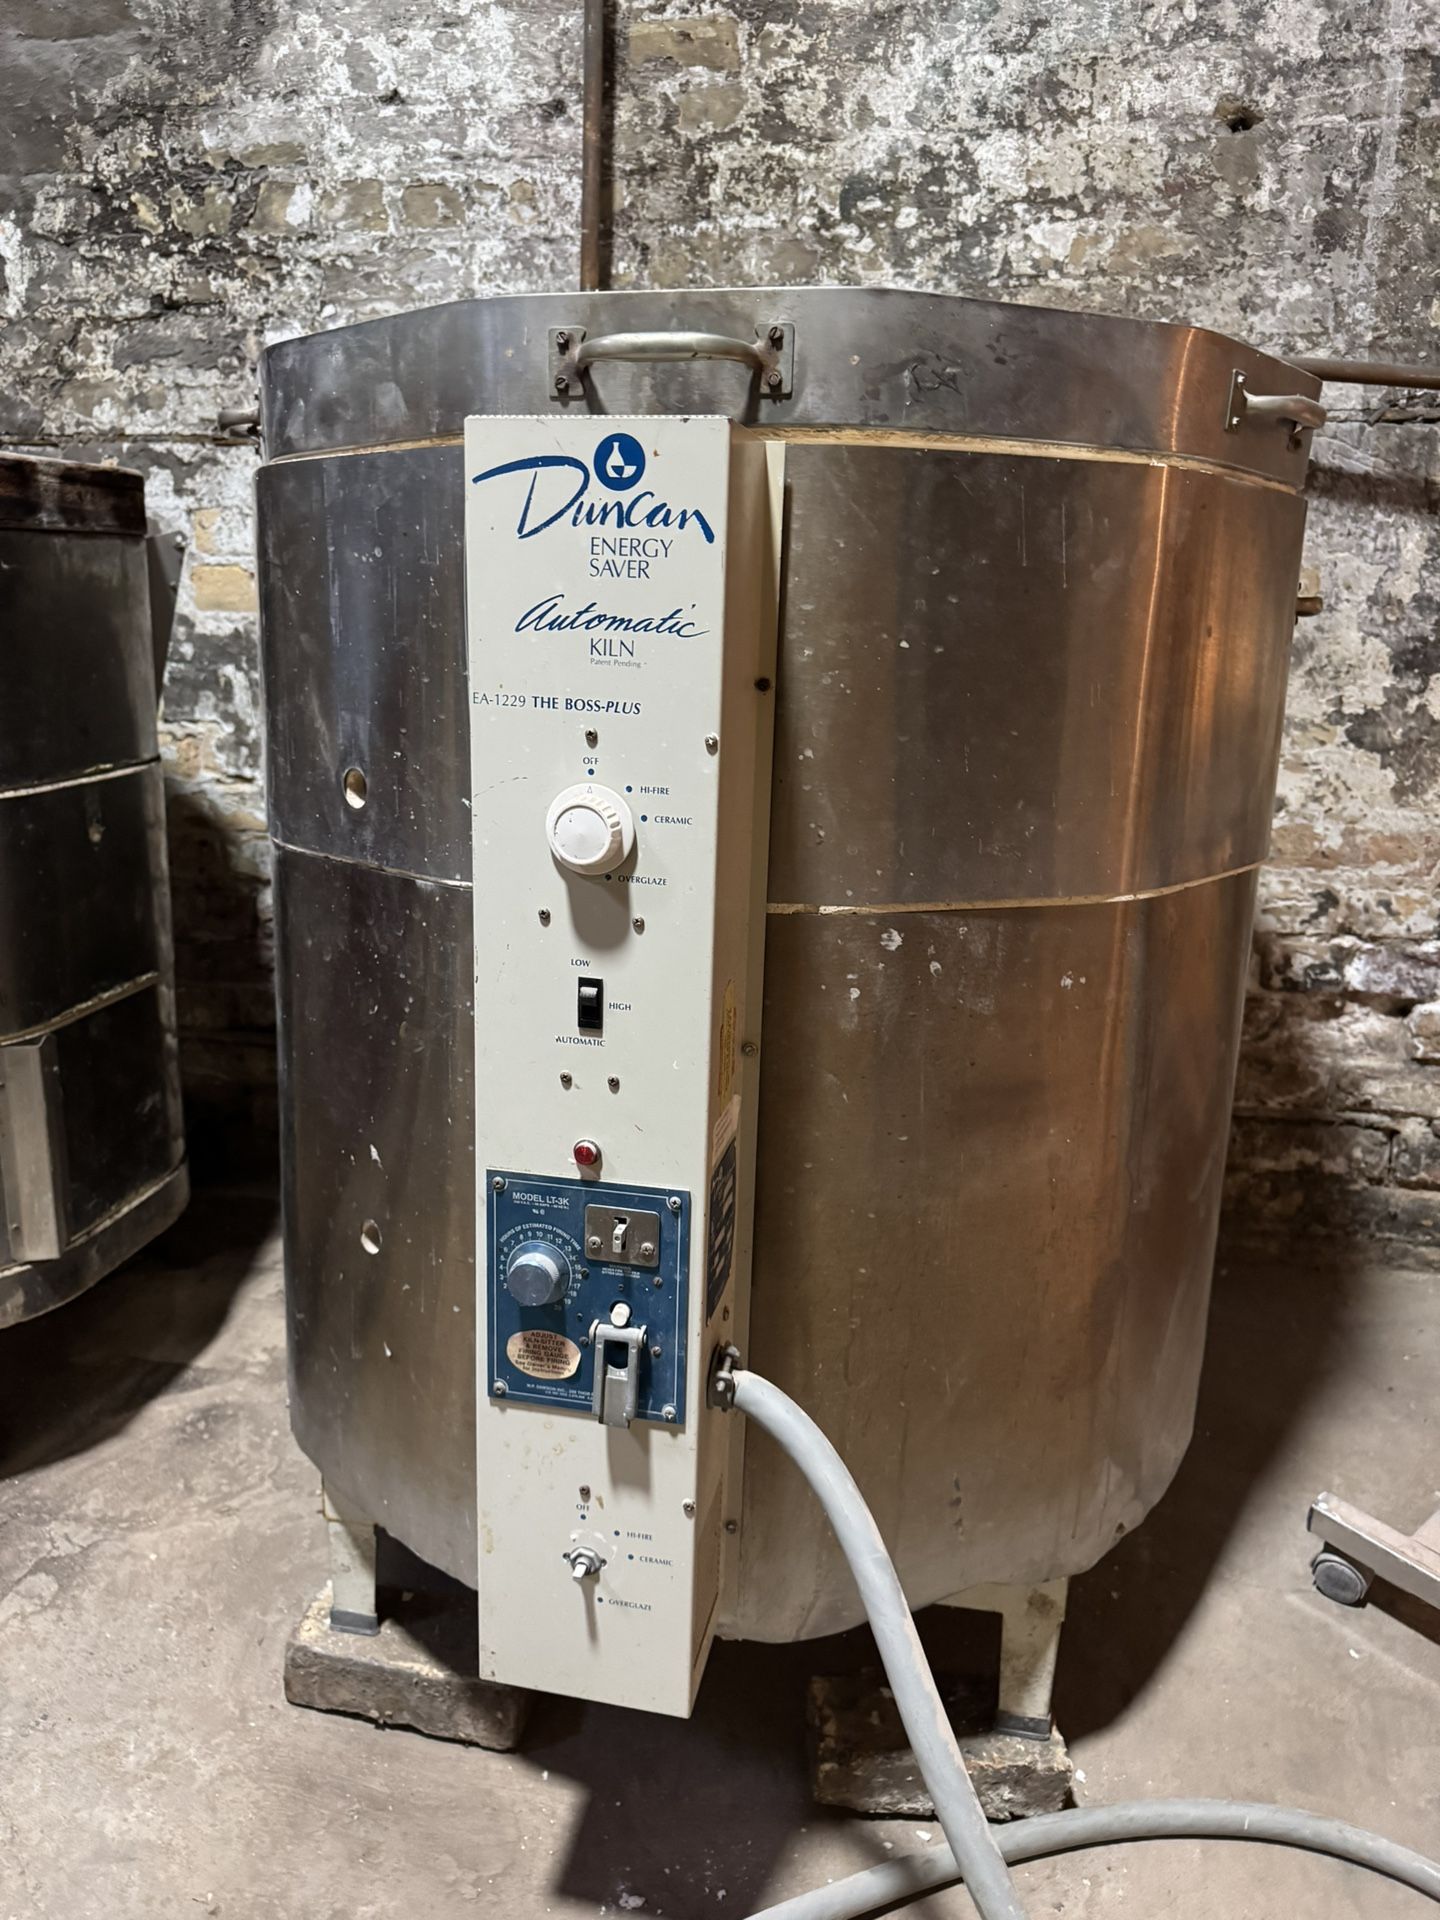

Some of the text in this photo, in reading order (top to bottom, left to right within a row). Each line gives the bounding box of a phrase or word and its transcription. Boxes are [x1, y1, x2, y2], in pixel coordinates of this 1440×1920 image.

[472, 455, 715, 544] Duncan
[591, 537, 673, 558] ENERGY
[589, 558, 650, 579] SAVER
[515, 594, 711, 638] Automatic
[589, 637, 635, 657] KILN
[590, 657, 641, 669] Patent Pending
[472, 691, 641, 715] EA-1229 THE BOSS-PLUS
[583, 757, 599, 765] OFF
[640, 785, 670, 795] HI-FIRE
[654, 815, 693, 826] CERAMIC
[618, 874, 667, 886] OVERGLAZE
[570, 959, 591, 968] LOW
[608, 1001, 632, 1011] HIGH
[555, 1035, 606, 1047] AUTOMATIC
[512, 1191, 545, 1203] MODEL
[546, 1195, 569, 1206] LT-3K
[530, 1332, 557, 1340] ADJUST
[518, 1348, 569, 1360] FIRING GAUGE
[532, 1344, 563, 1353] REMOVE
[517, 1354, 571, 1366] BEFORE FIRING
[626, 1531, 653, 1541] HI-FIRE
[639, 1556, 673, 1567] CERAMIC
[608, 1599, 652, 1611] OVERGLAZE
